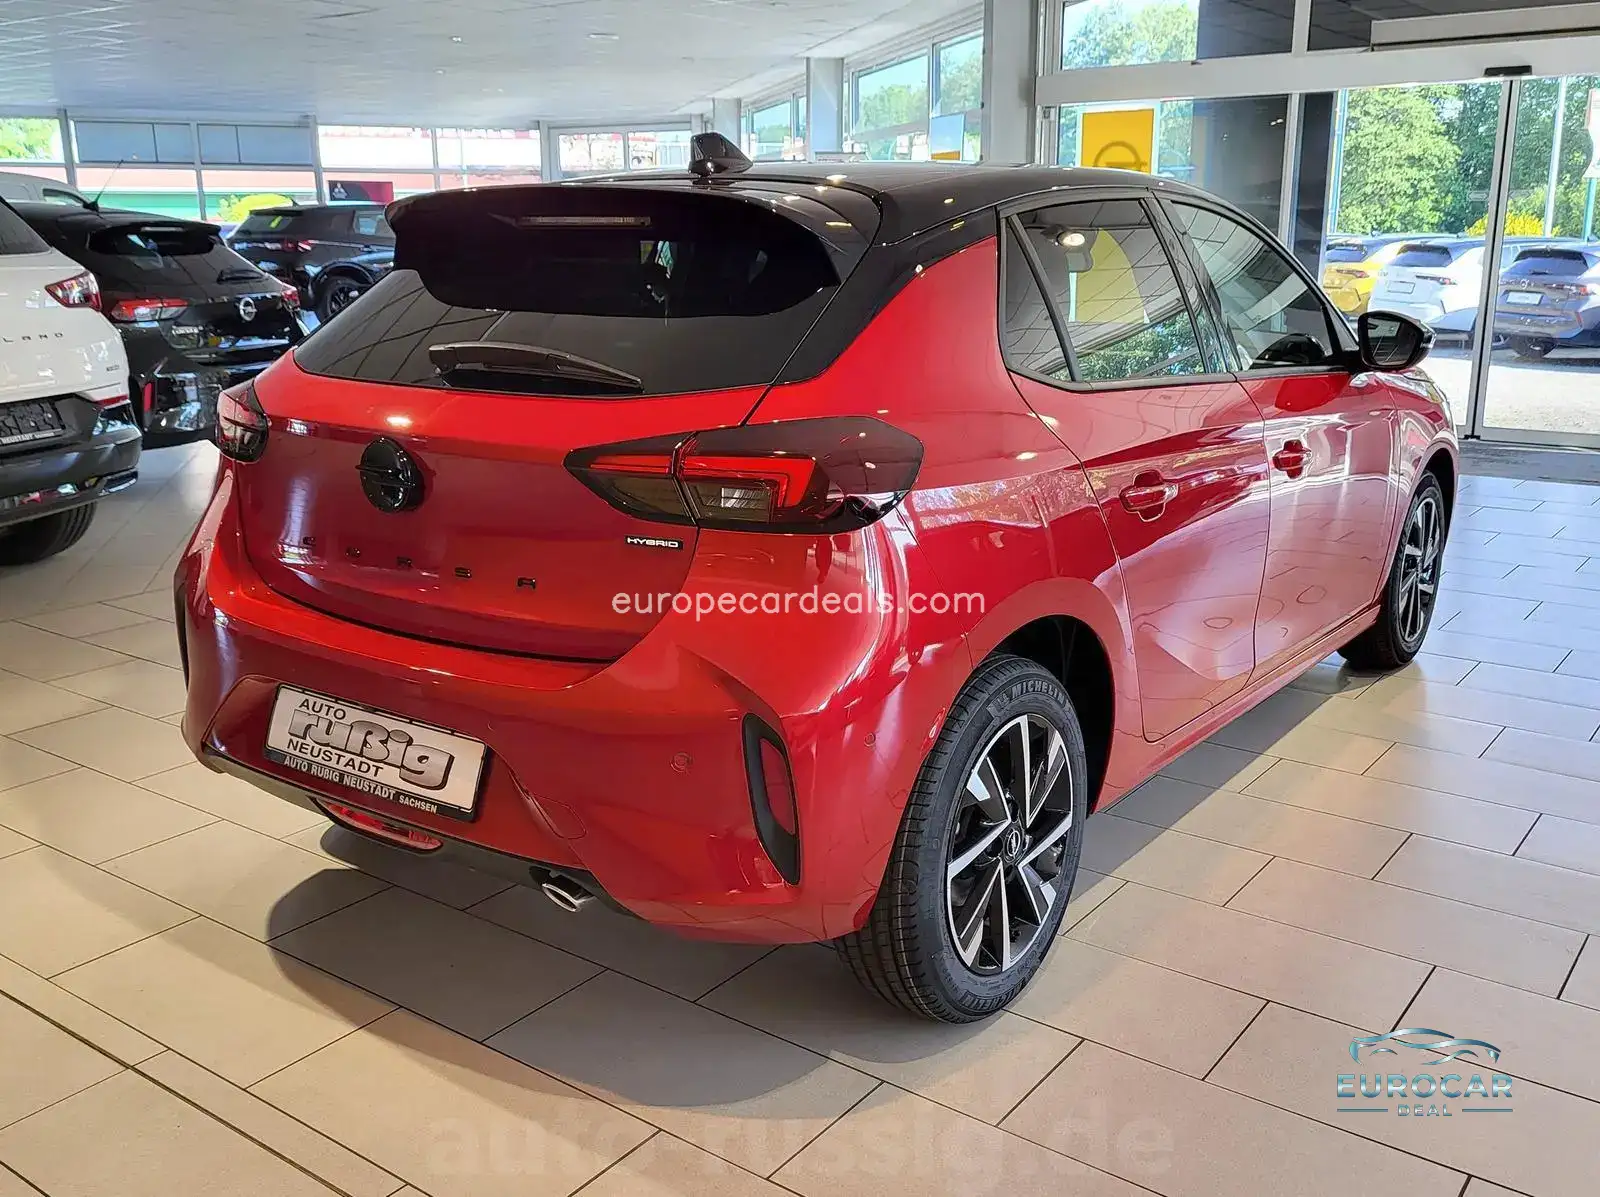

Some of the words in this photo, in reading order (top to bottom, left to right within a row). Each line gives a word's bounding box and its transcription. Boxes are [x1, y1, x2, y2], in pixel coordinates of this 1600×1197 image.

[627, 537, 679, 548] HYBRID
[1011, 680, 1067, 704] MICHELIN
[299, 698, 346, 720] AUTO
[286, 738, 384, 778] NEUSTADT
[283, 755, 308, 773] AUTO
[343, 774, 396, 800] NEUSTADT
[398, 794, 438, 815] SACHSEN
